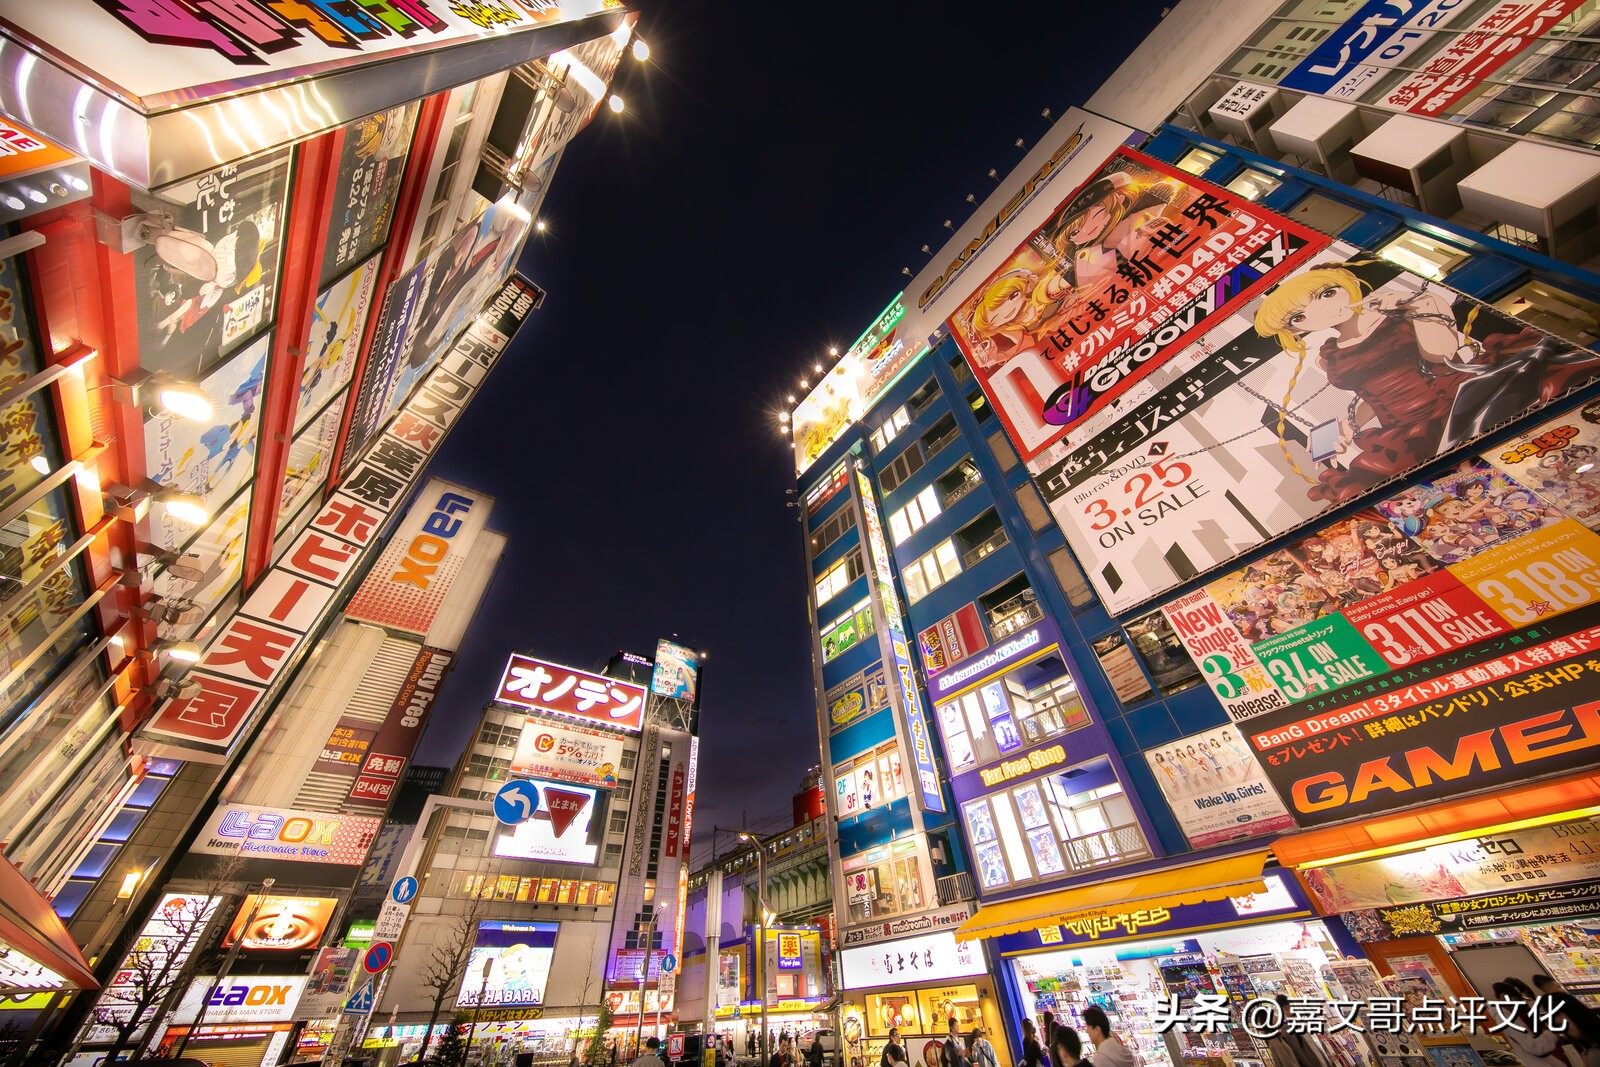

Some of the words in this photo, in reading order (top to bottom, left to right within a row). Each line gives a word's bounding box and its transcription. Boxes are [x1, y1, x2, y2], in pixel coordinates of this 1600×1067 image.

[1151, 213, 1257, 299] #D4DJ
[1084, 337, 1131, 381] D4DJ
[1084, 451, 1193, 531] 3.25
[1098, 520, 1136, 549] ON
[1137, 478, 1210, 527] SALE
[1552, 547, 1597, 573] ON
[1165, 598, 1183, 614] BanG
[1184, 588, 1209, 608] Dream!
[1421, 598, 1457, 623] ON
[1351, 610, 1370, 624] Easy
[1442, 611, 1502, 643] SALE
[1187, 626, 1236, 657] Single
[1307, 641, 1339, 664] ON
[425, 653, 450, 689] Duty
[1324, 654, 1373, 685] SALE
[505, 666, 642, 718] オノデン
[1227, 688, 1287, 722] Release!
[400, 689, 429, 728] Free
[898, 664, 930, 763] マツモトキヨシ
[1256, 725, 1304, 749] BanG
[1309, 702, 1375, 734] Dream!
[368, 757, 401, 773] 免税
[980, 767, 1004, 787] Tax
[1003, 758, 1032, 781] Free
[1029, 744, 1067, 770] Shop
[838, 779, 847, 795] 2F
[847, 793, 856, 810] 3F
[1194, 795, 1223, 810] Wake
[1237, 783, 1267, 798] Girls!
[550, 799, 579, 811] 止まれ
[668, 776, 684, 854] ラブメルシー
[685, 800, 693, 818] LOVE
[207, 838, 240, 850] Home
[241, 841, 298, 855] Electronics
[301, 845, 328, 857] Store
[892, 916, 931, 934] maidreamin
[782, 935, 798, 956] 薬
[259, 1008, 282, 1016] STORE
